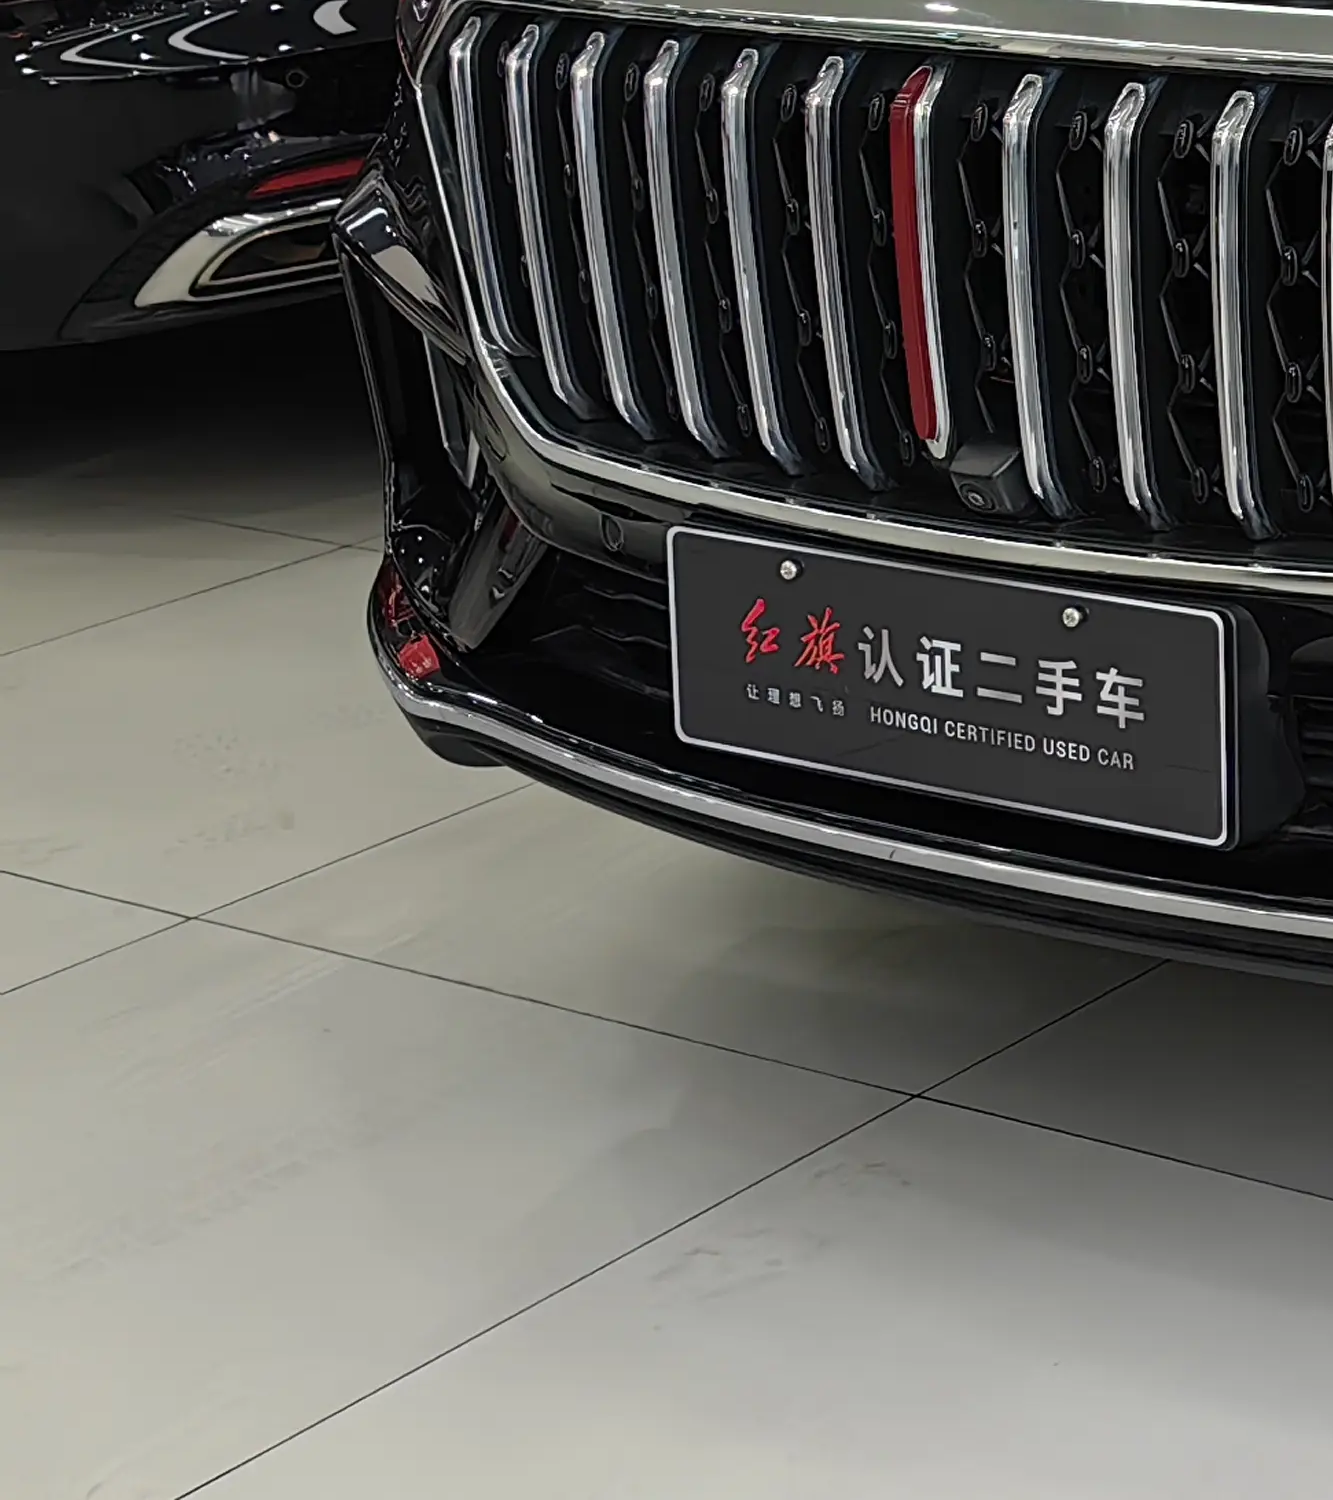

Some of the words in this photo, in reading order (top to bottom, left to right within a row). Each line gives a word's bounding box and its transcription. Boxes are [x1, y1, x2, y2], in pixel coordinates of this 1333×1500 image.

[742, 599, 1145, 728] 红旗认证二手车
[871, 707, 937, 734] HONGQI
[945, 721, 1035, 751] CERTIFIED
[1044, 738, 1089, 761] USED
[1098, 748, 1133, 769] CAR
